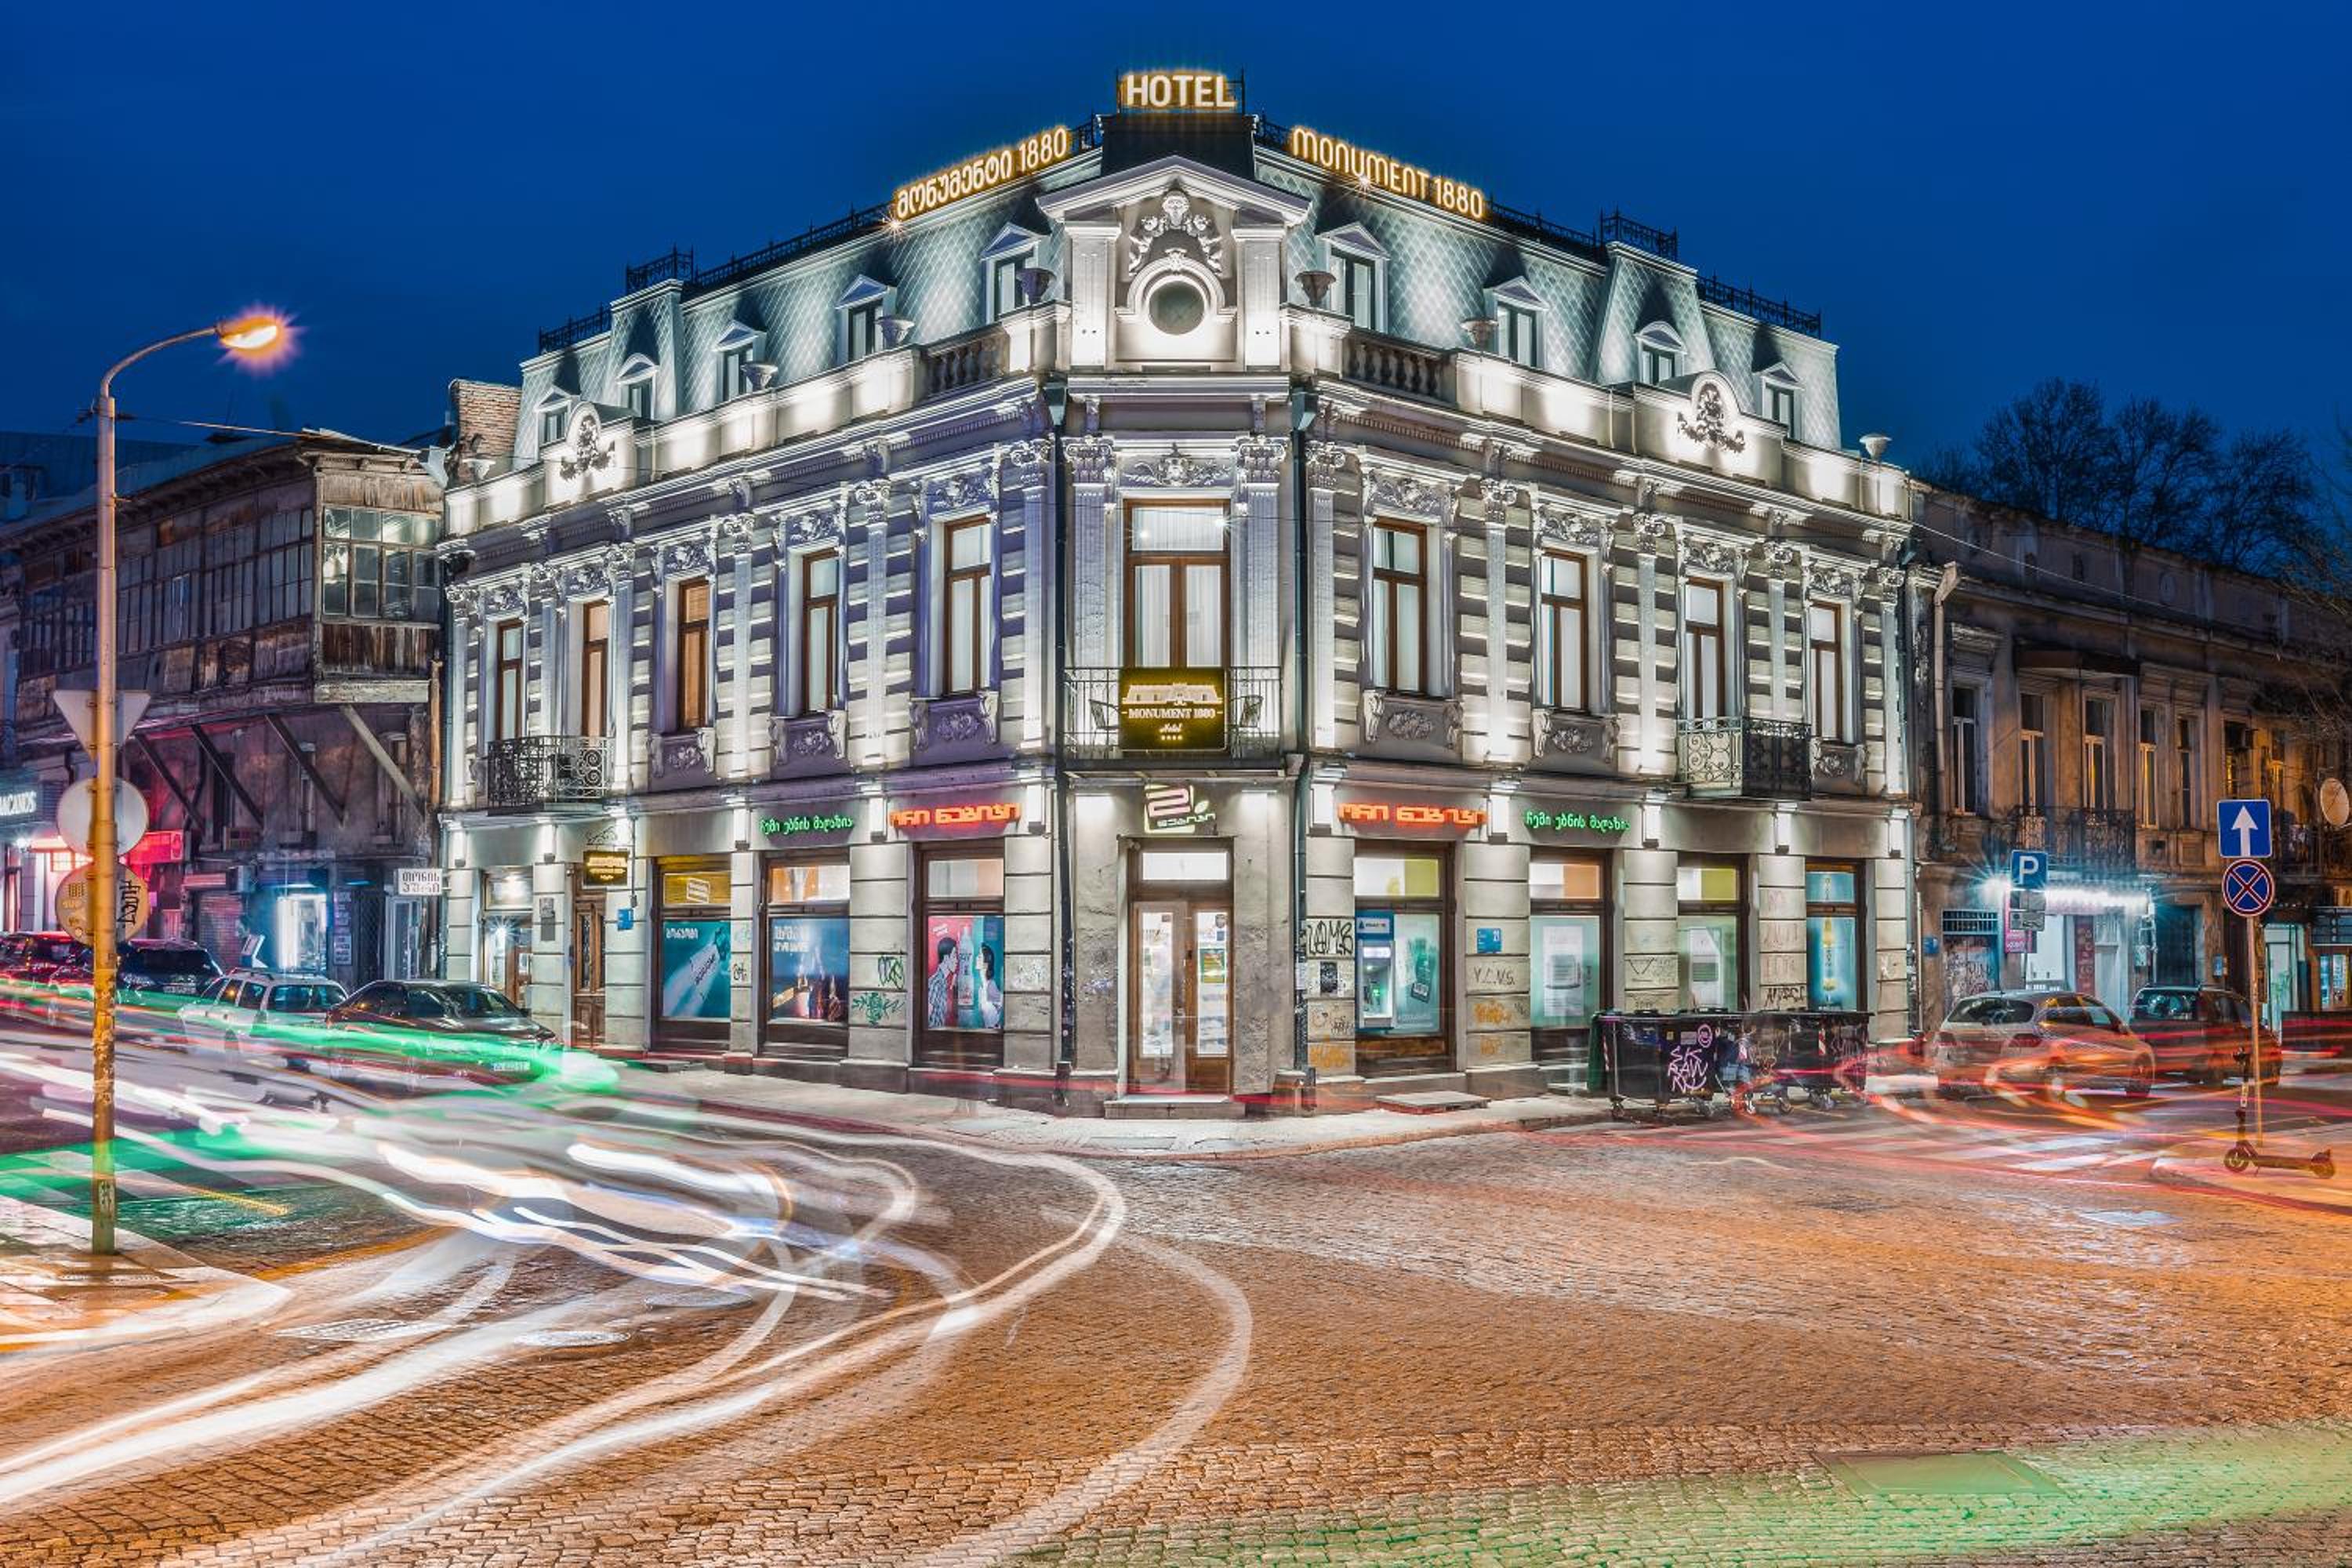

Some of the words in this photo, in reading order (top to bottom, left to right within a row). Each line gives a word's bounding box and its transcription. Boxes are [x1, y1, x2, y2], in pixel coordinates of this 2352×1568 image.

[1127, 74, 1237, 107] HOTEL
[897, 150, 1011, 218] მონუმენტი
[1018, 128, 1067, 172] 1880
[1294, 128, 1430, 199] MONUMENT
[1434, 177, 1483, 218] 1880
[1128, 708, 1192, 719] MONUMENT
[1193, 708, 1216, 719] 1880
[2020, 856, 2039, 884] P
